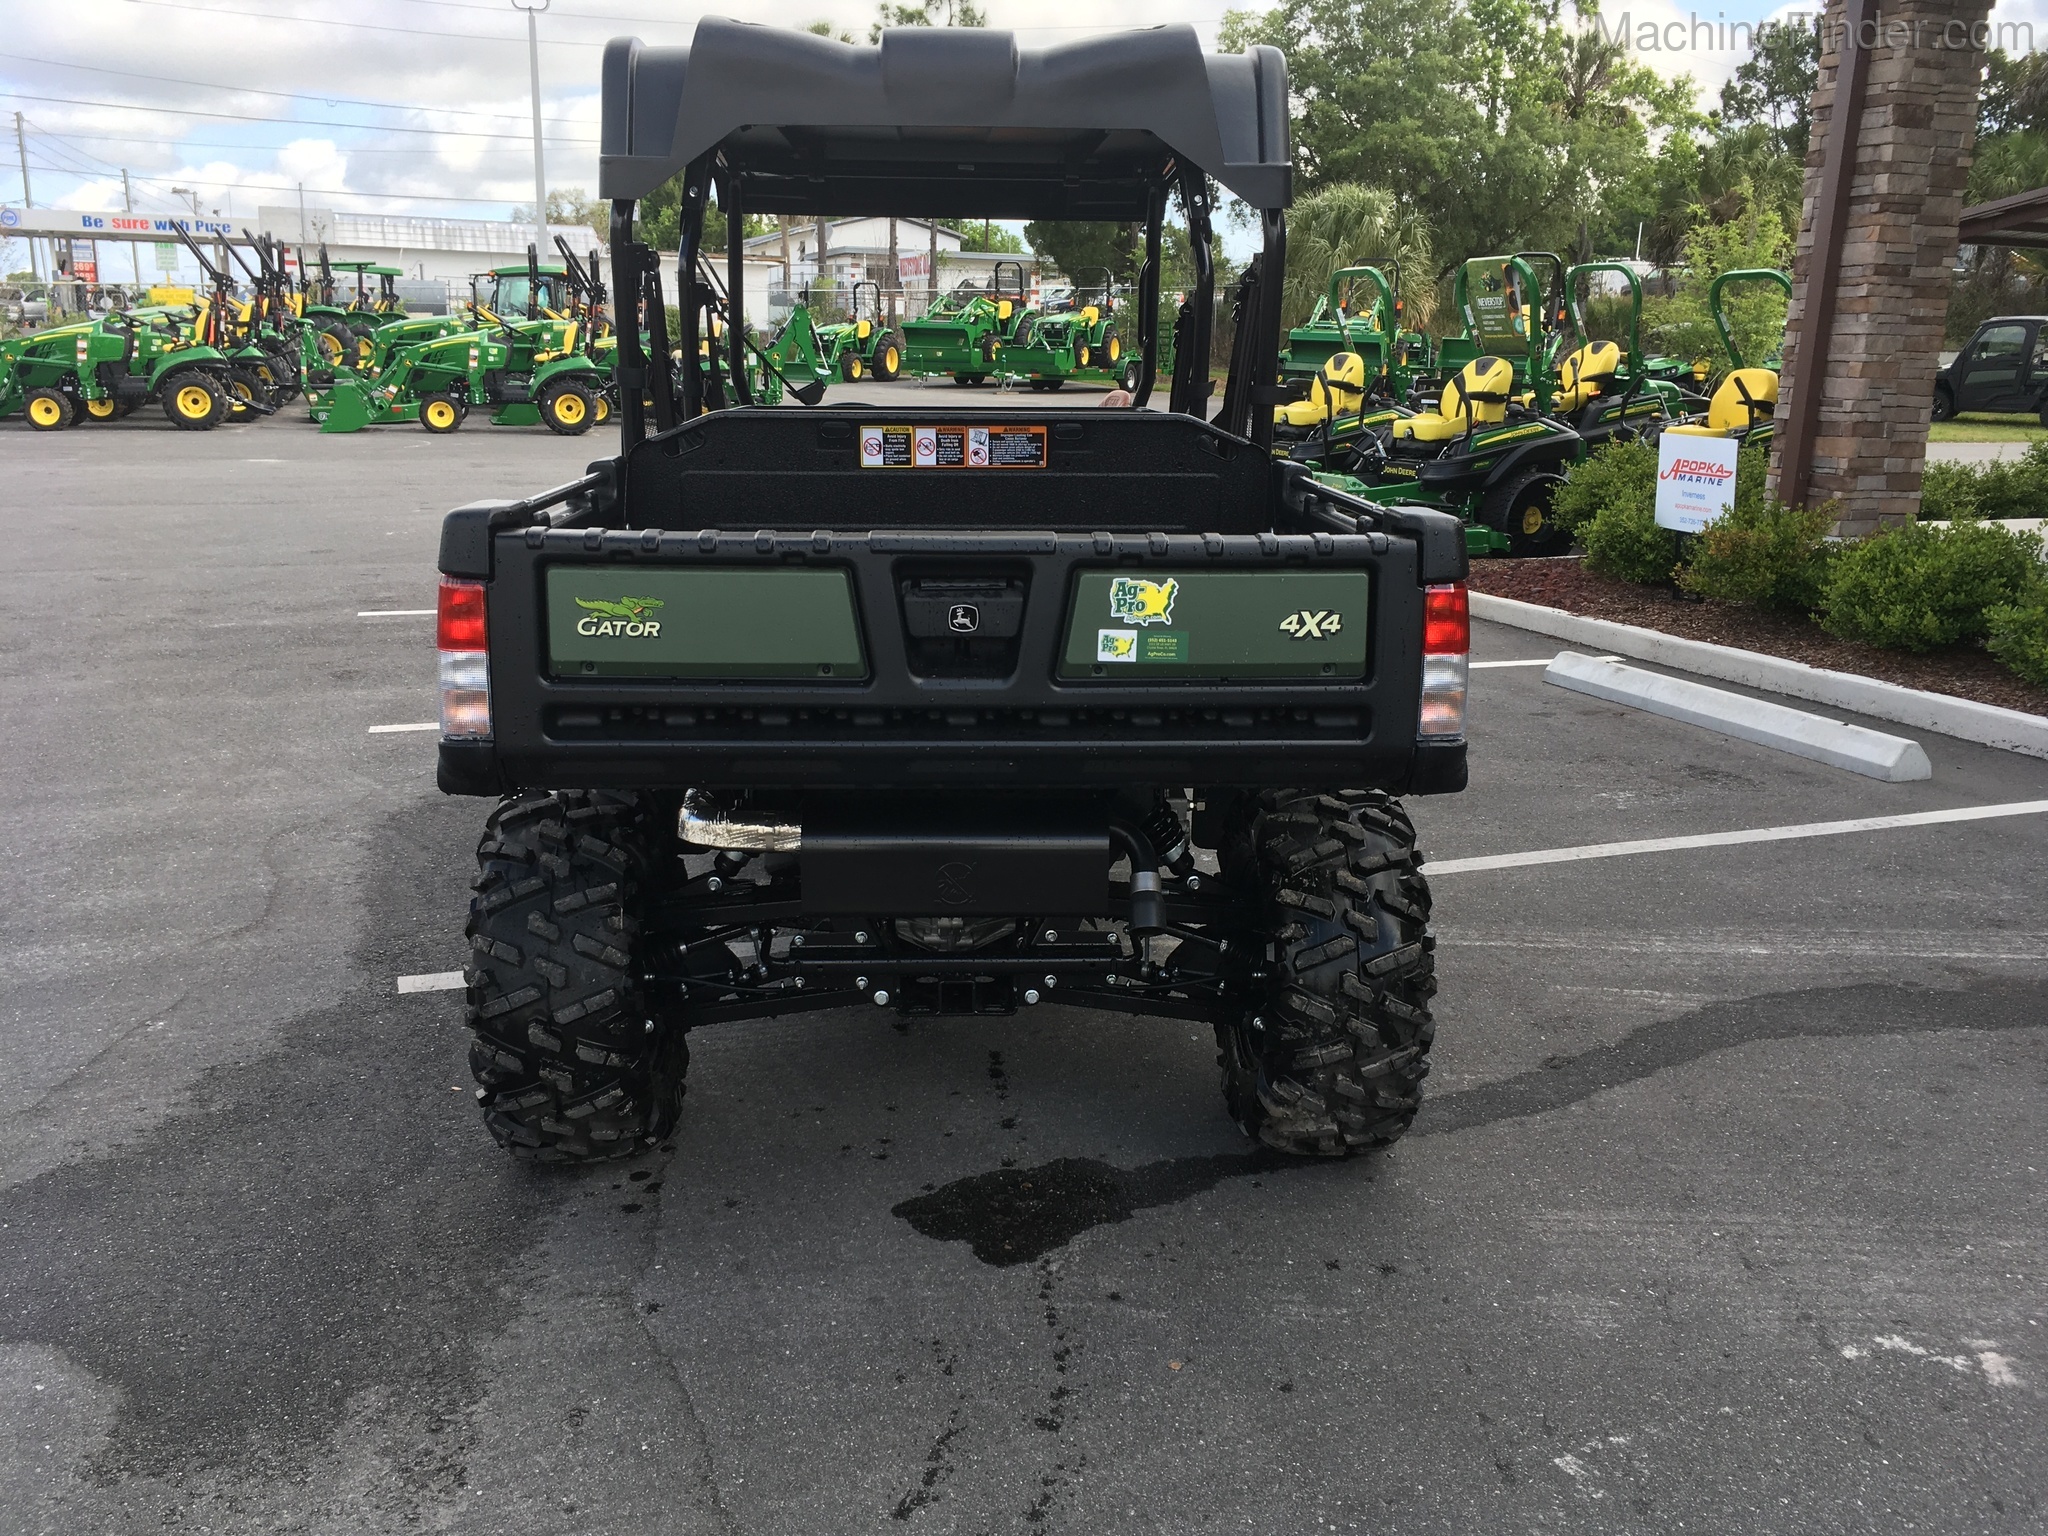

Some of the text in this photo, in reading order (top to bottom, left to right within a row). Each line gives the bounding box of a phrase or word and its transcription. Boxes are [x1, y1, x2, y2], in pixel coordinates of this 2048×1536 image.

[82, 215, 103, 228] Be
[112, 218, 149, 230] sure
[154, 219, 189, 231] wih
[1383, 466, 1416, 477] JOHN DEERE
[1660, 459, 1733, 480] APOPKA
[1678, 474, 1724, 486] MARINE
[1115, 598, 1146, 613] Pro
[577, 617, 661, 637] GATOR
[1279, 611, 1342, 638] 4X4
[1101, 644, 1118, 652] Pro
